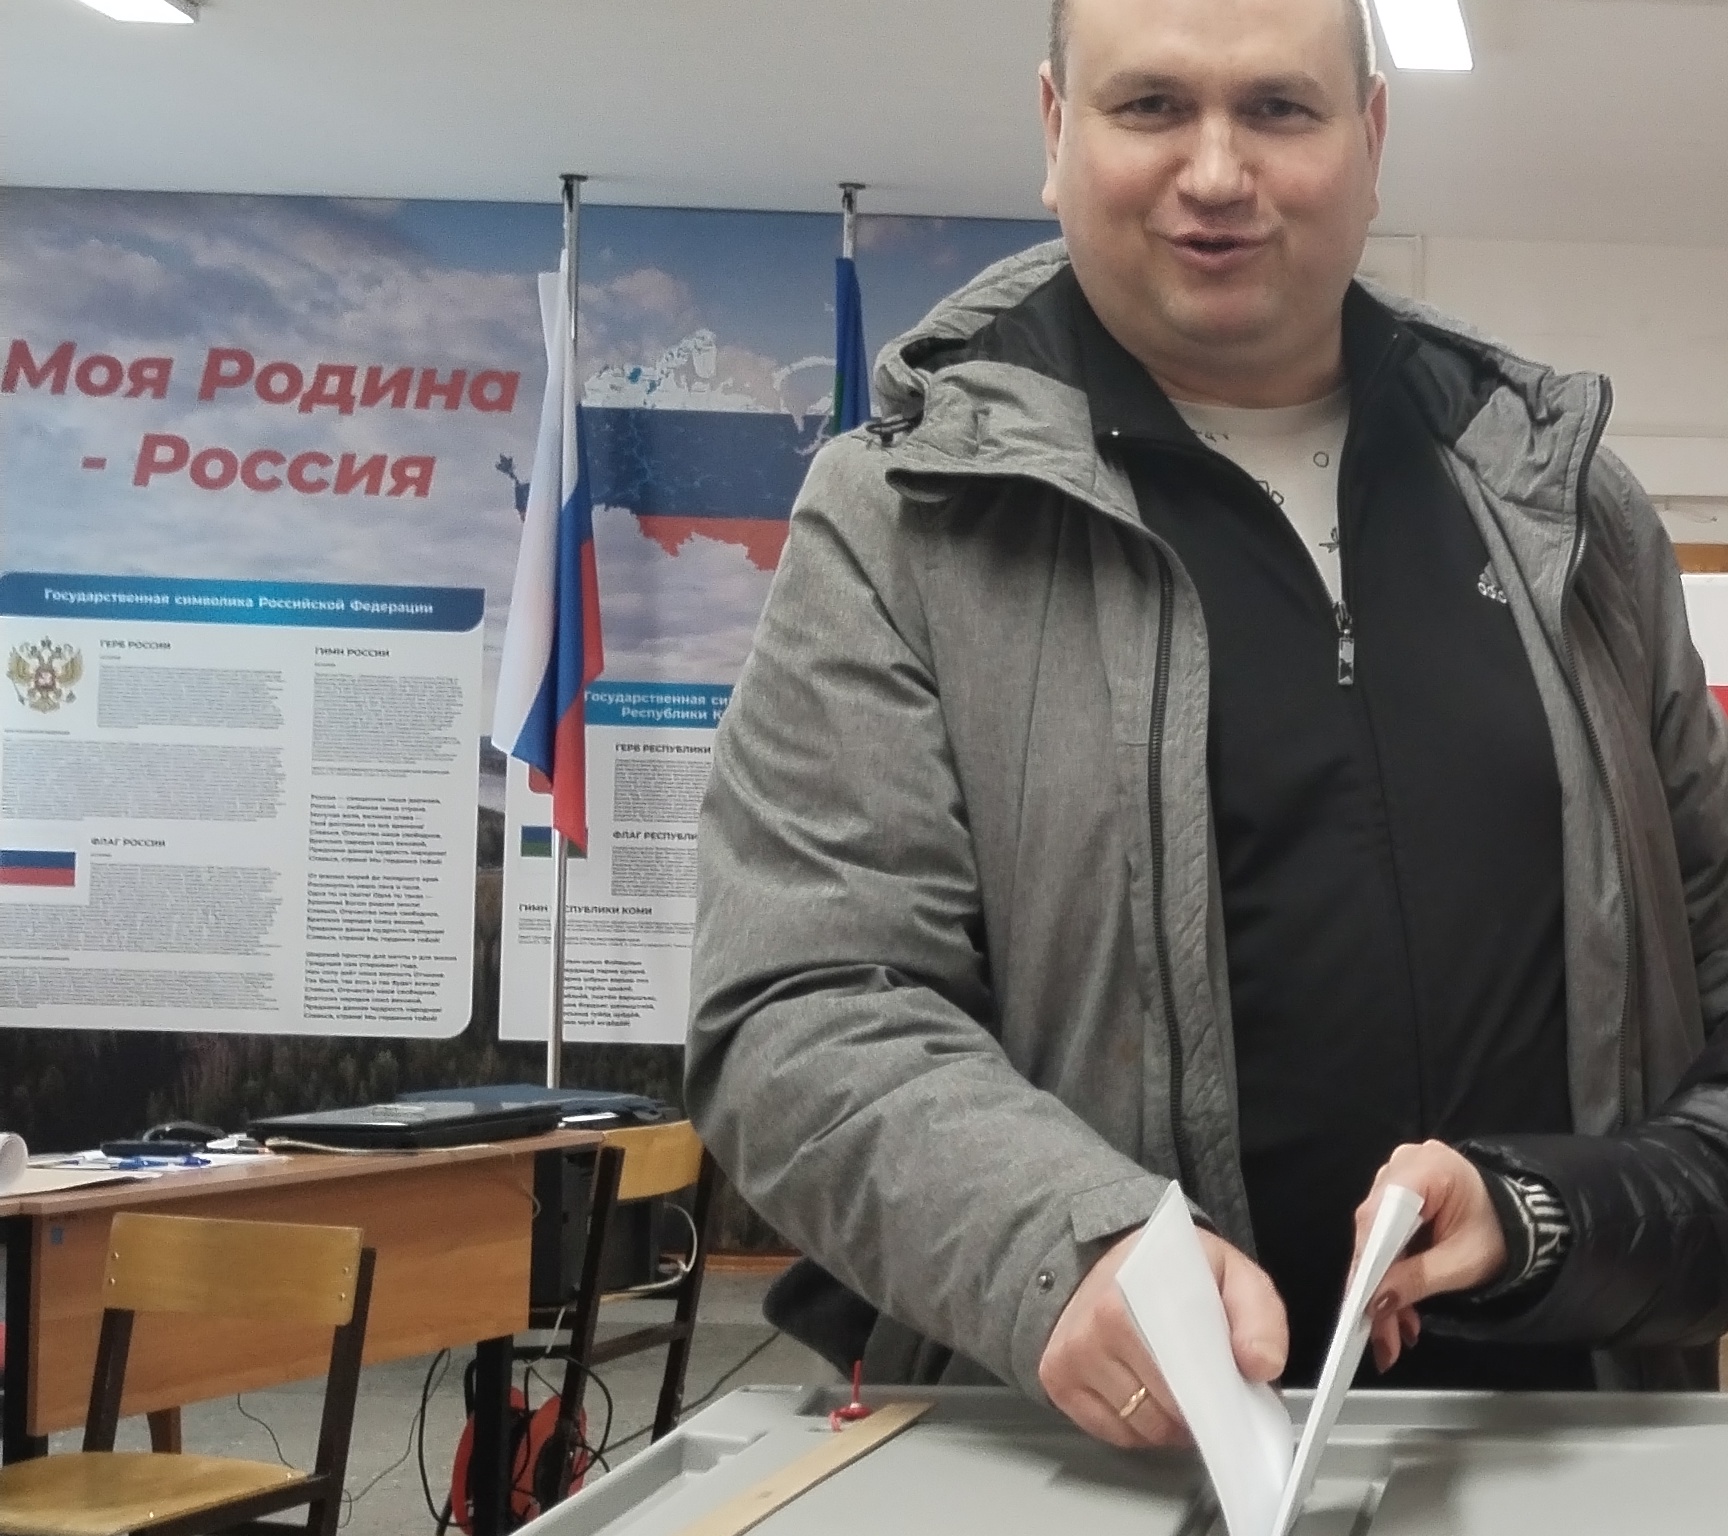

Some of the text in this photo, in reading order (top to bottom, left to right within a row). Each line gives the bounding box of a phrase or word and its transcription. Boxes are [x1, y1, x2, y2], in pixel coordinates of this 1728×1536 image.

[1, 338, 521, 416] Моя Родина
[132, 432, 437, 498] Россия
[43, 586, 434, 615] Государственная символика Российской Федерации
[128, 640, 172, 651] РОССИИ
[346, 647, 391, 659] РОССИИ
[584, 690, 706, 706] Государственная
[621, 706, 708, 721] Республики
[642, 744, 711, 755] РЕСПУБЛИКИ
[643, 831, 698, 841] РЕСПУБЛИ
[123, 838, 166, 848] РОССИИ
[565, 904, 620, 915] СПУБЛИКИ
[621, 906, 653, 915] КОМИ
